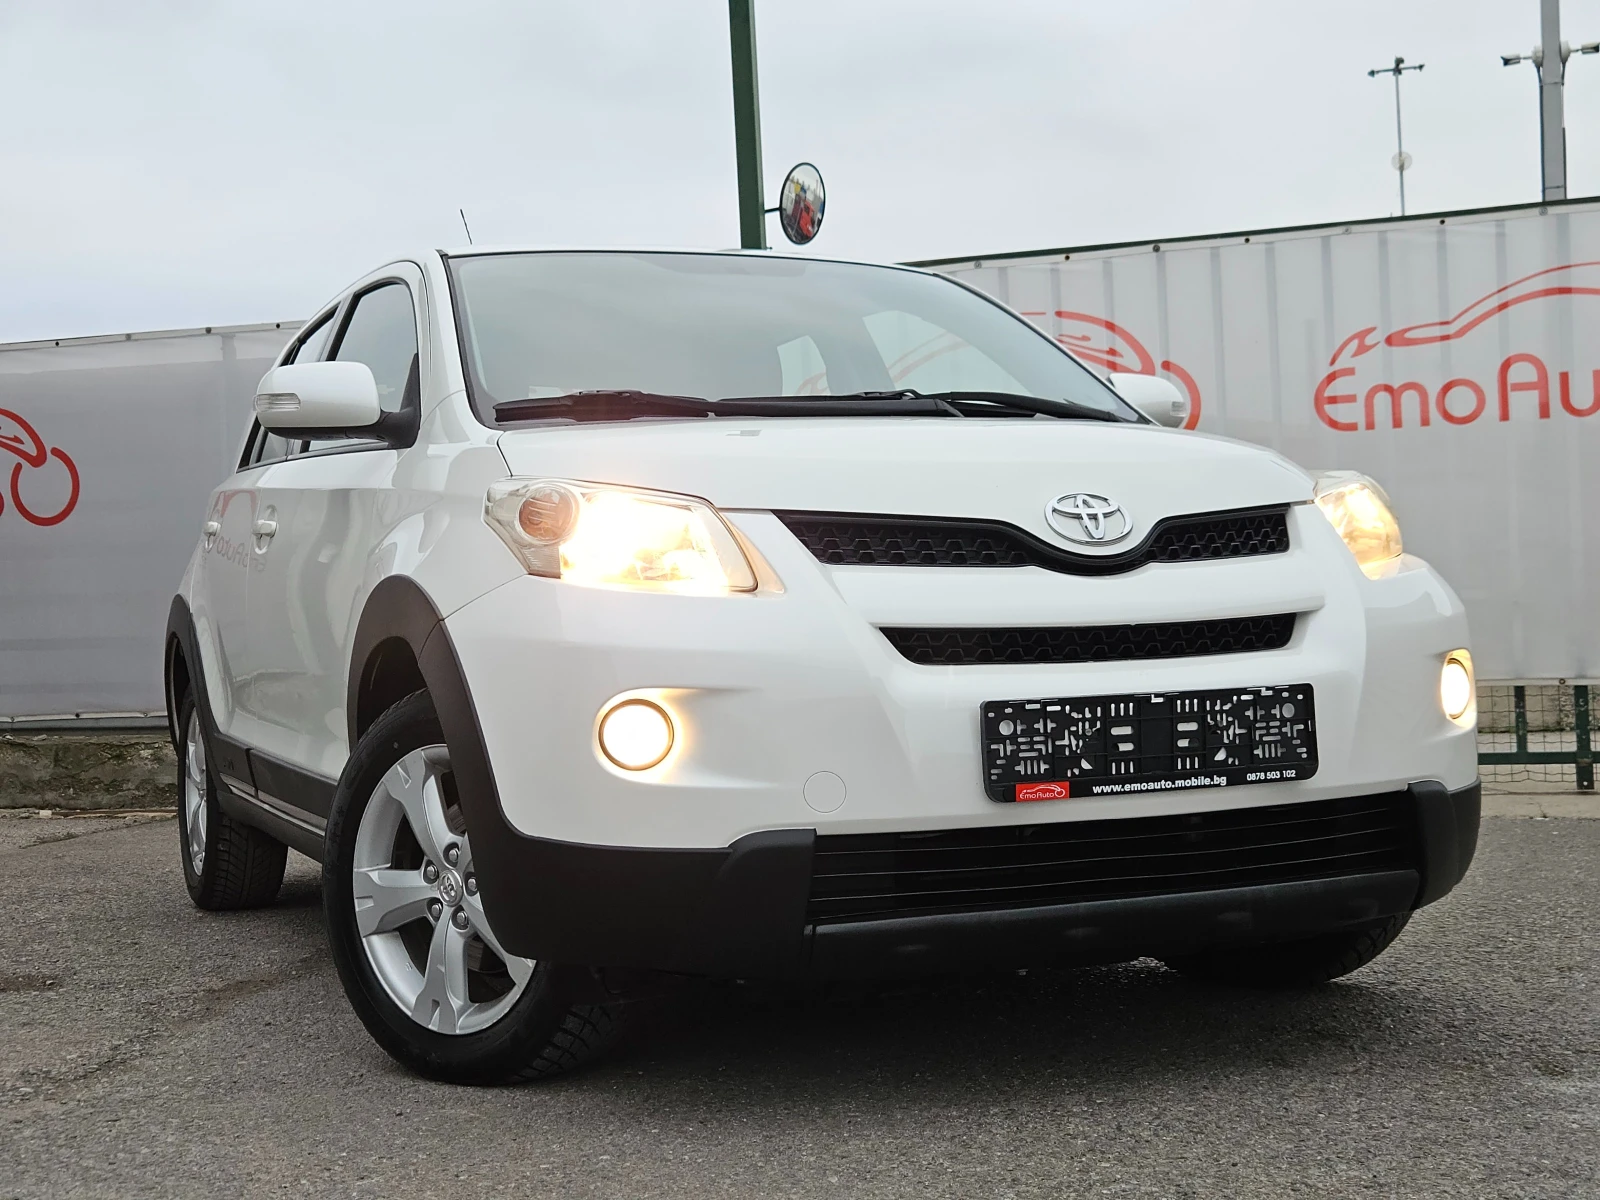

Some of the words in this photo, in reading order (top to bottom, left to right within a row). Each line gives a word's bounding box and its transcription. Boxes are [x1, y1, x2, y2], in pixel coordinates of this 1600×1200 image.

[1246, 772, 1265, 781] 0878
[1266, 771, 1281, 779] 503
[1282, 769, 1296, 778] 102
[1092, 775, 1227, 793] www.emoauto.mobile.bg
[1020, 791, 1055, 799] EmoAuto
